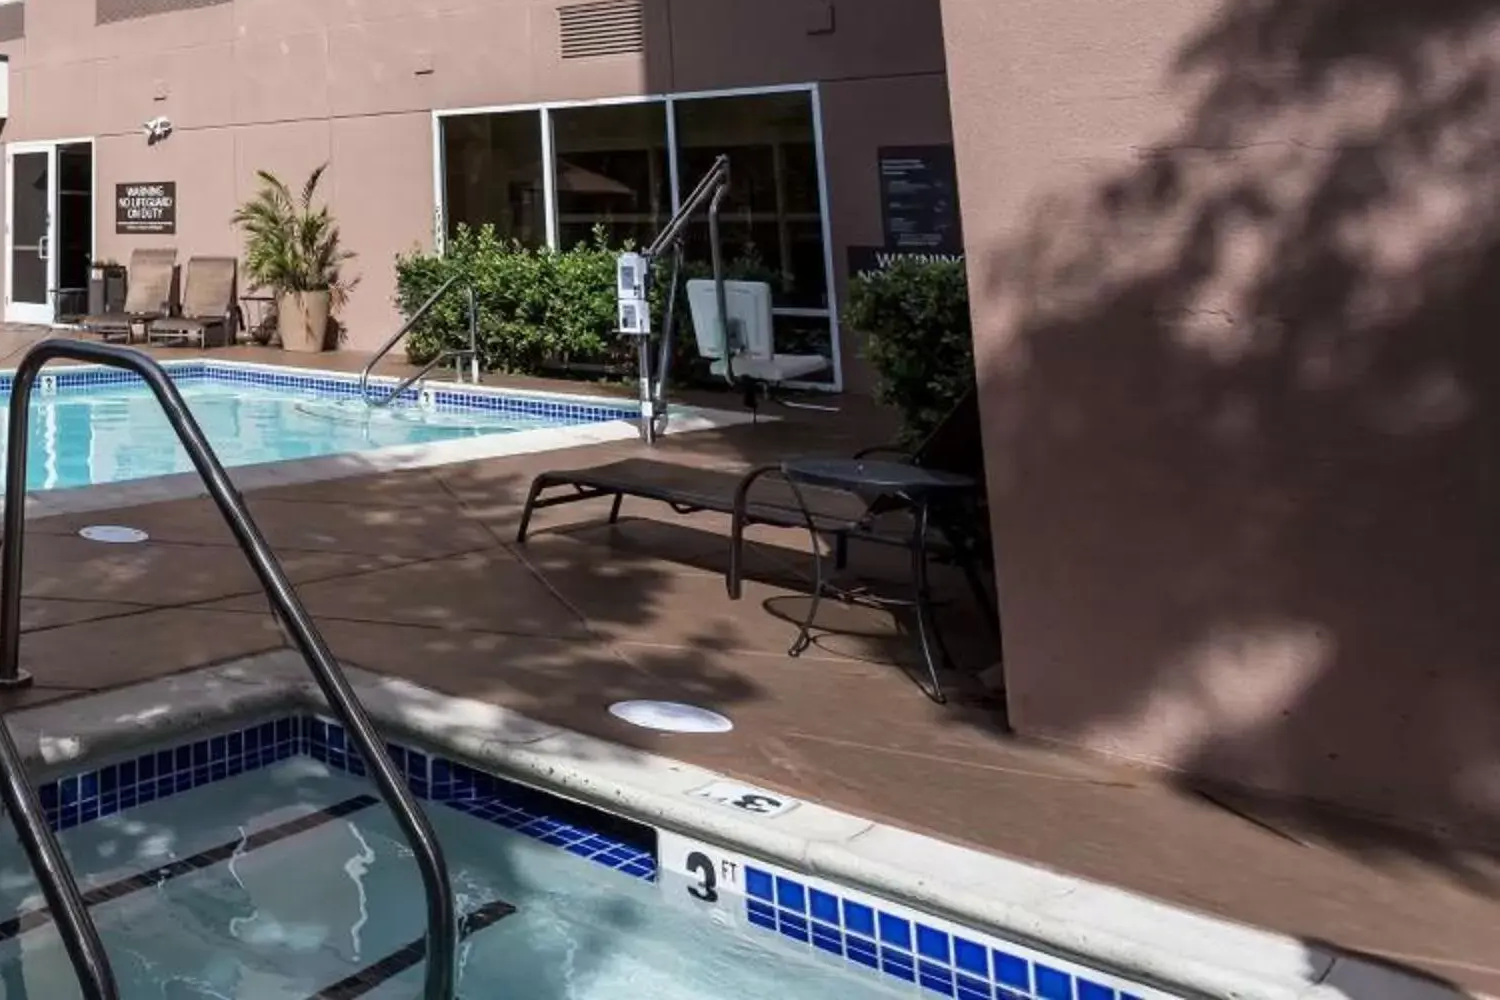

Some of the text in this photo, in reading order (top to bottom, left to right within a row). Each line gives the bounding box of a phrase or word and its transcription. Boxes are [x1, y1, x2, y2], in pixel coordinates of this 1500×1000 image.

[126, 186, 164, 197] WARNING
[118, 197, 173, 208] NO LIFEGUARD
[127, 208, 163, 219] ON DUTY
[732, 794, 782, 813] 3
[686, 851, 738, 903] 3 FT
